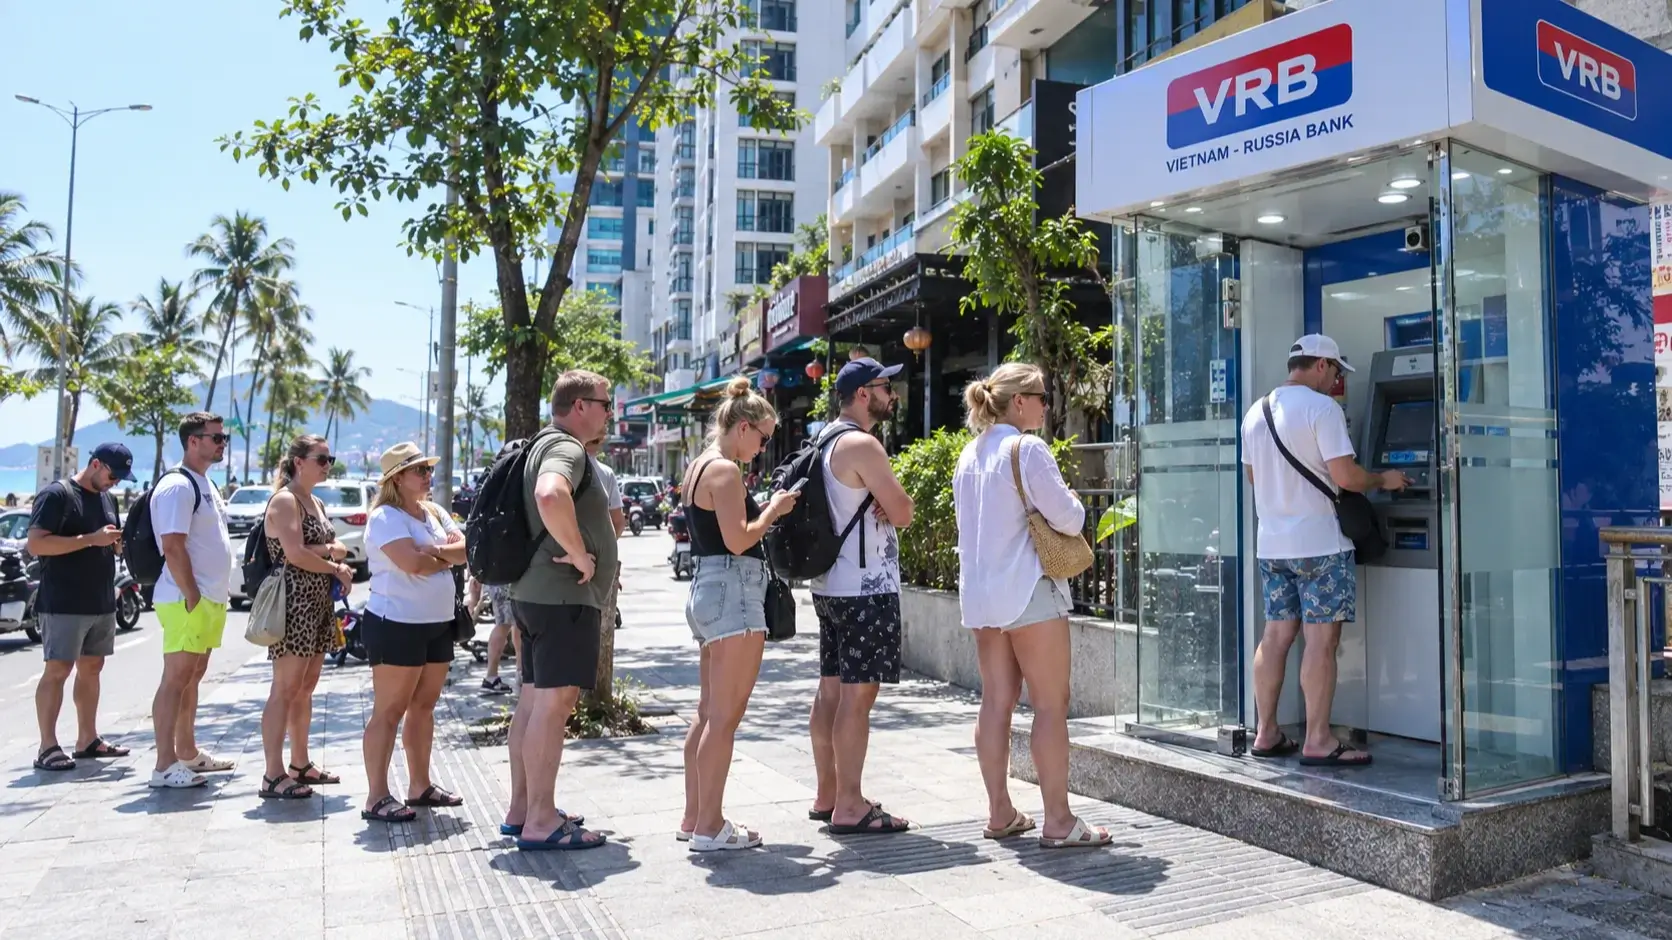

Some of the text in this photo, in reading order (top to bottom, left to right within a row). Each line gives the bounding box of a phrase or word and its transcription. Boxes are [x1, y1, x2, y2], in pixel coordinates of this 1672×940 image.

[1193, 53, 1318, 125] VRB
[1554, 40, 1621, 100] VRB
[1166, 145, 1229, 173] VIETNAM
[1243, 128, 1301, 154] RUSSIA
[1306, 113, 1354, 139] BANK
